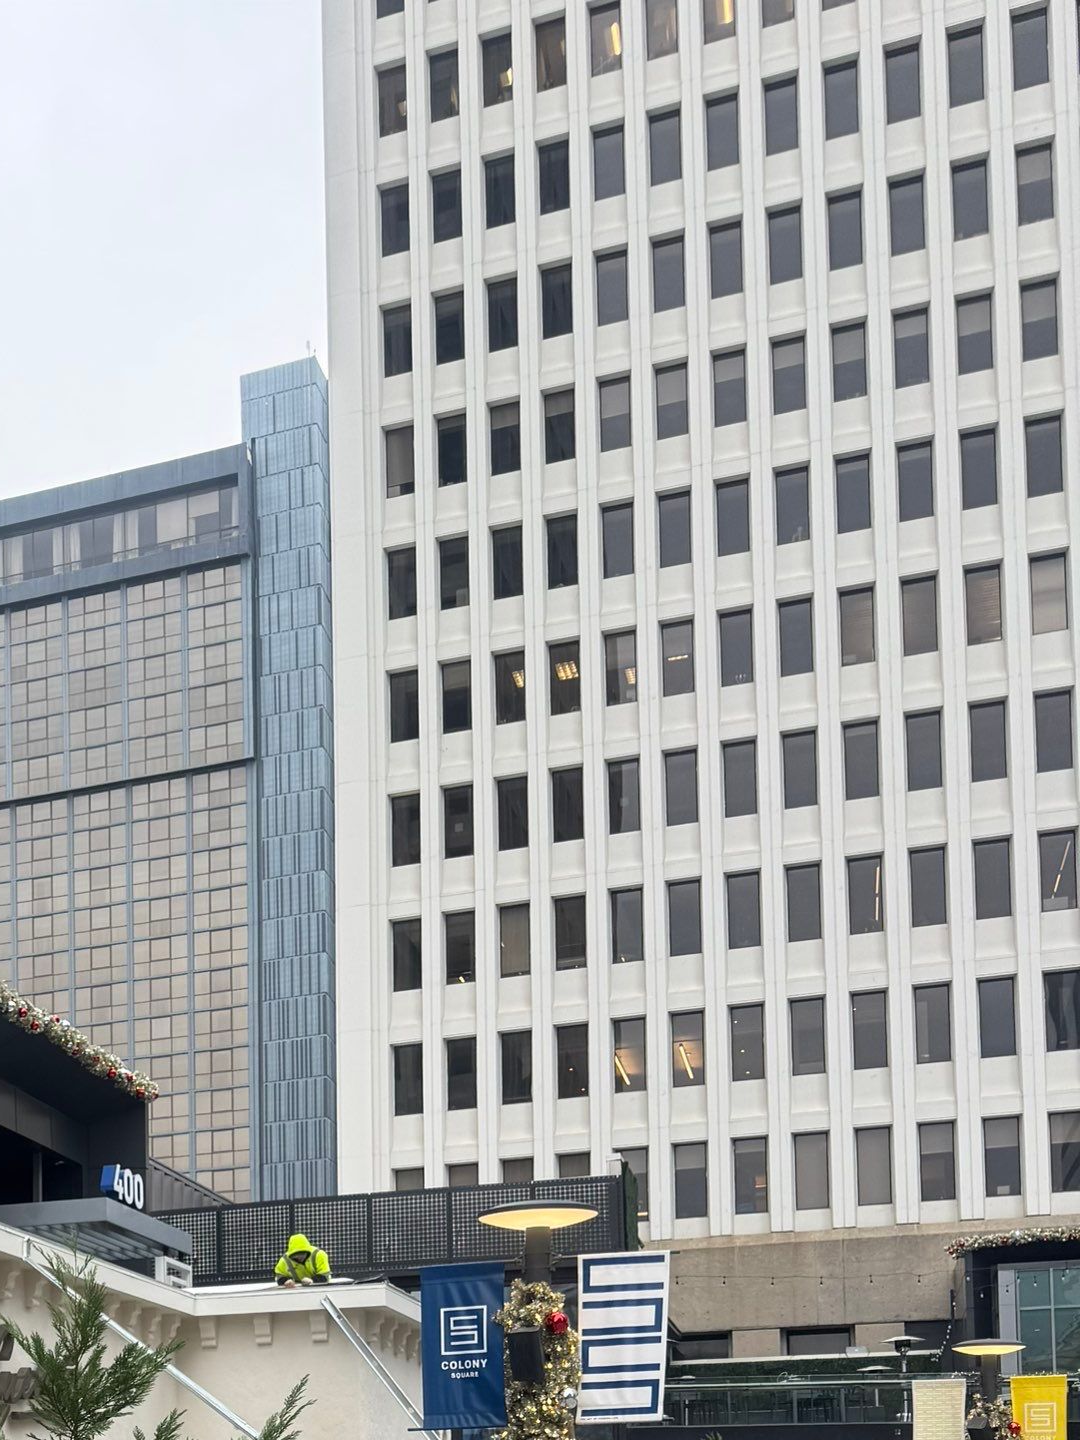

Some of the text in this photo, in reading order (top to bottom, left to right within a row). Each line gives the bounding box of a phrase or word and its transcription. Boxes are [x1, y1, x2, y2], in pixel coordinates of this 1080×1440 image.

[113, 1164, 144, 1210] 400
[441, 1359, 488, 1371] COLONY
[450, 1371, 480, 1379] SQUARE
